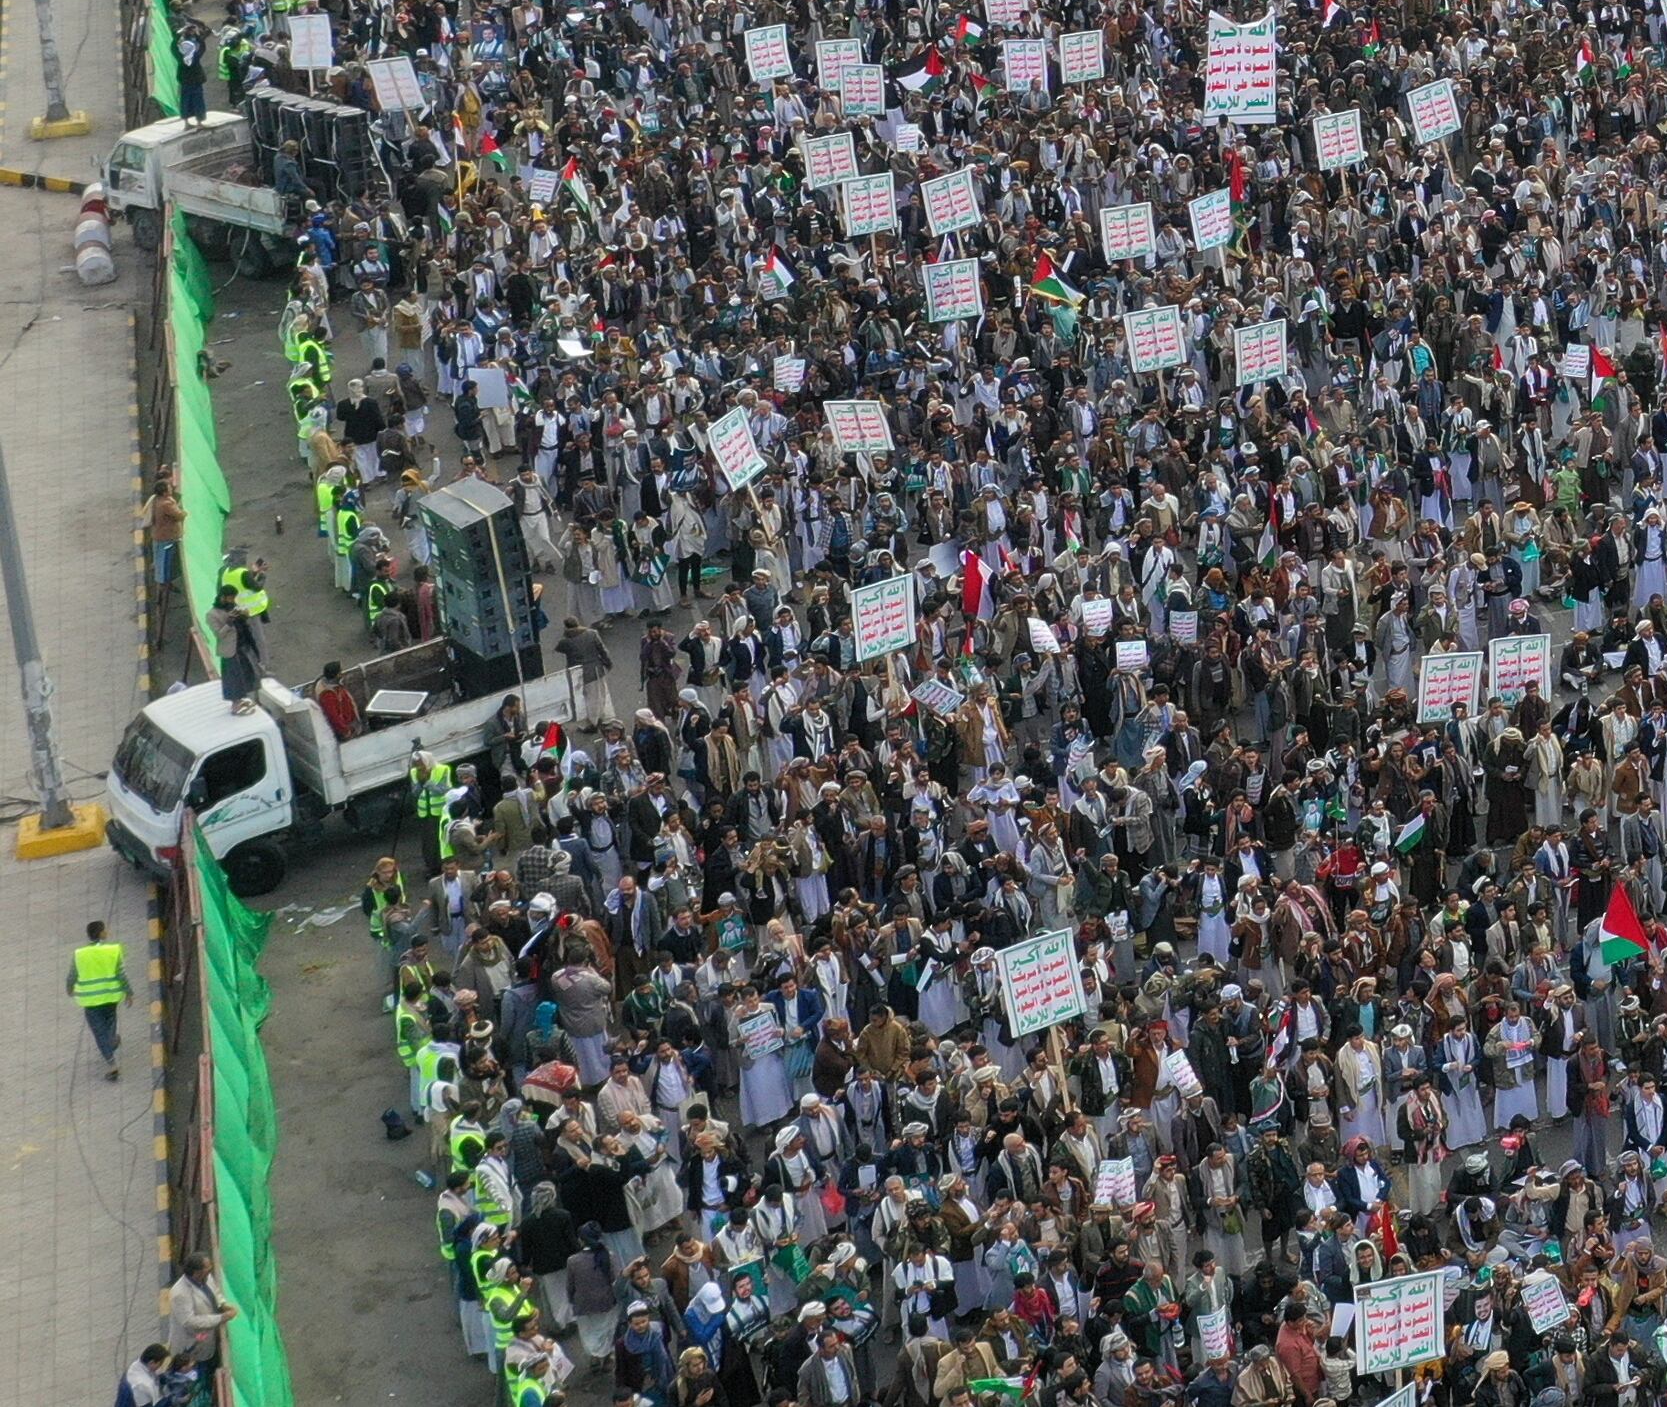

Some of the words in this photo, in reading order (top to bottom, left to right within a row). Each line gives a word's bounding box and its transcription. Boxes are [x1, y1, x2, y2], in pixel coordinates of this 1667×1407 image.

[1249, 22, 1273, 35] الله
[1244, 43, 1273, 55] الموت
[1245, 60, 1273, 73] الموت
[1243, 92, 1273, 110] النصر
[1045, 940, 1064, 955] الله
[1043, 956, 1066, 971] الموت
[1046, 971, 1070, 986] الموت
[1053, 1001, 1076, 1020] النصر
[1408, 1283, 1432, 1295] الله
[1405, 1298, 1432, 1312] الموت
[1405, 1313, 1432, 1327] الموت
[1407, 1341, 1432, 1362] النصر
